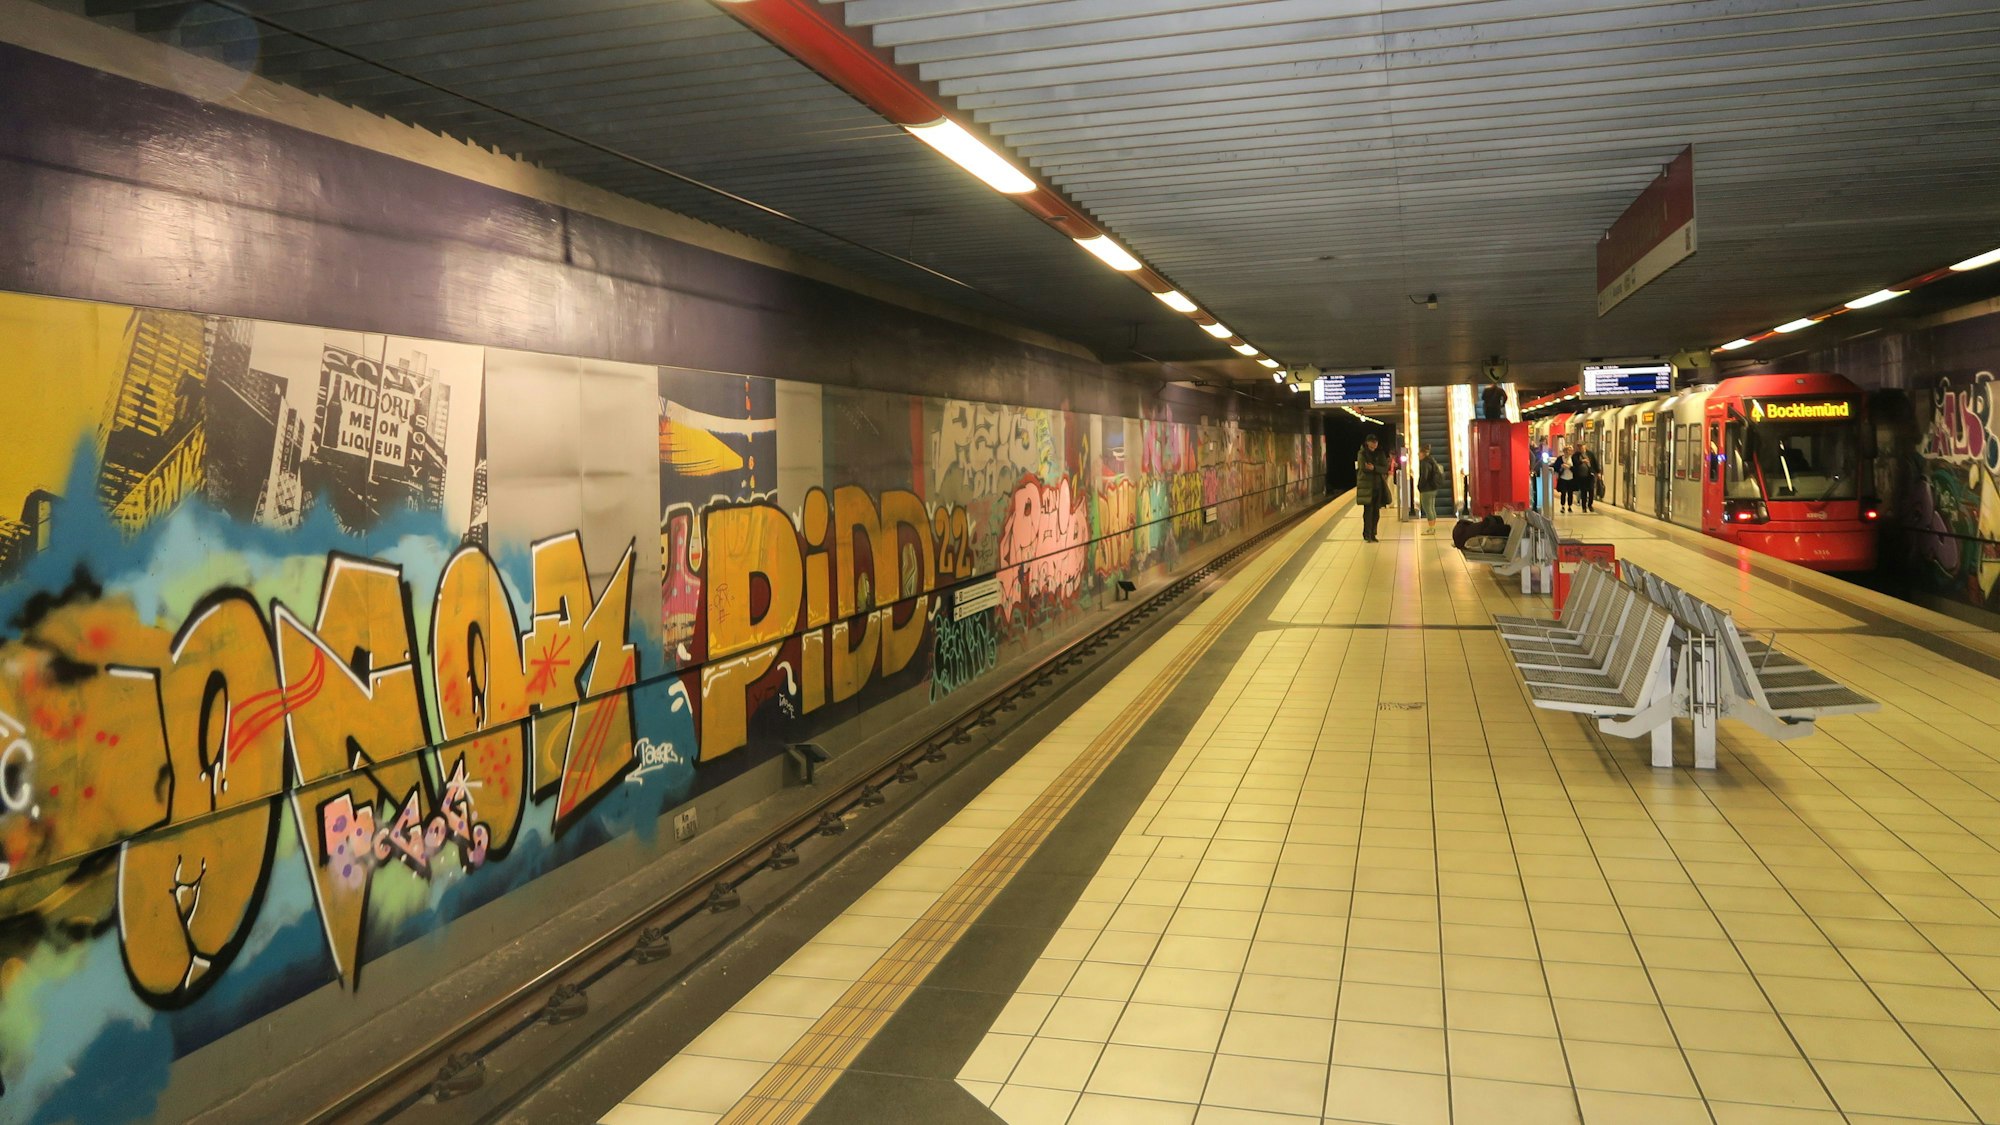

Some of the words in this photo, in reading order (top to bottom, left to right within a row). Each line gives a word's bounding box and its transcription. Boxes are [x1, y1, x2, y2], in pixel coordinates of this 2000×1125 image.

[323, 350, 432, 402] SONY
[342, 380, 413, 424] MIDORI
[1752, 400, 1765, 422] 4
[1767, 402, 1850, 419] Bocklemünd
[349, 411, 400, 438] MEON
[409, 414, 429, 478] SONY
